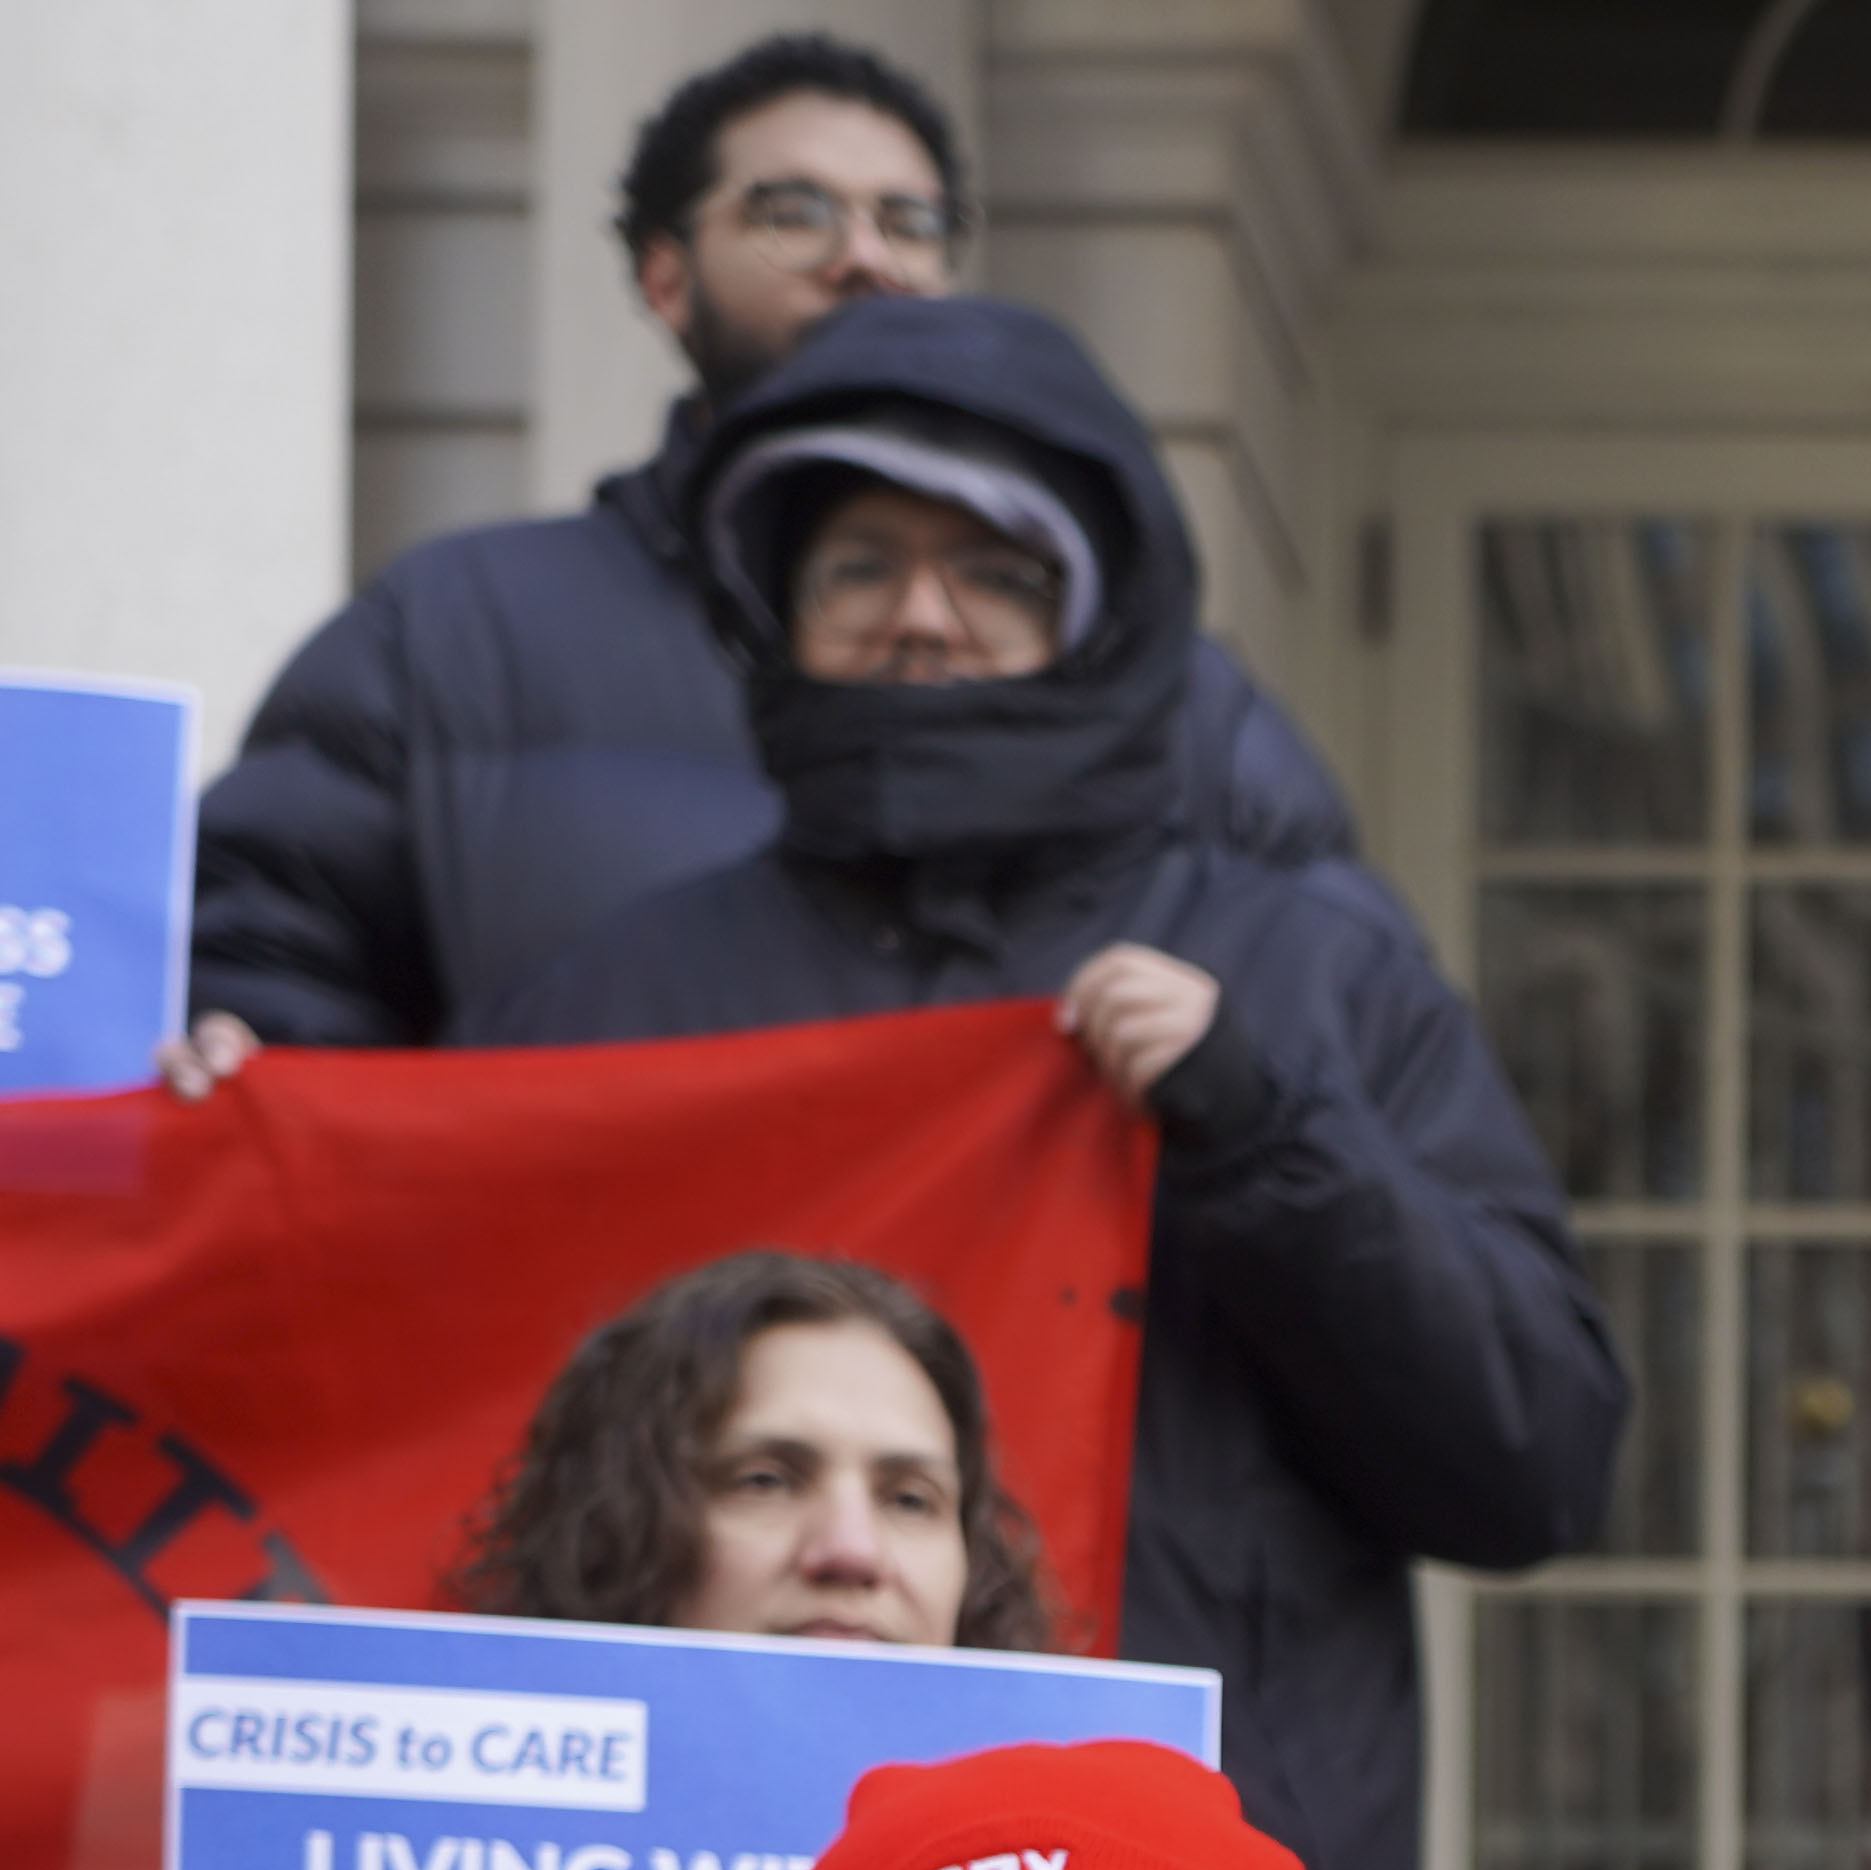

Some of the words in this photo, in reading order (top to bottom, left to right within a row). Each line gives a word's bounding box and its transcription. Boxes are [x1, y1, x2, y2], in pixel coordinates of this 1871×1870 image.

[187, 1707, 380, 1767] CRISIS
[396, 1724, 454, 1770] to
[471, 1722, 633, 1782] CARE
